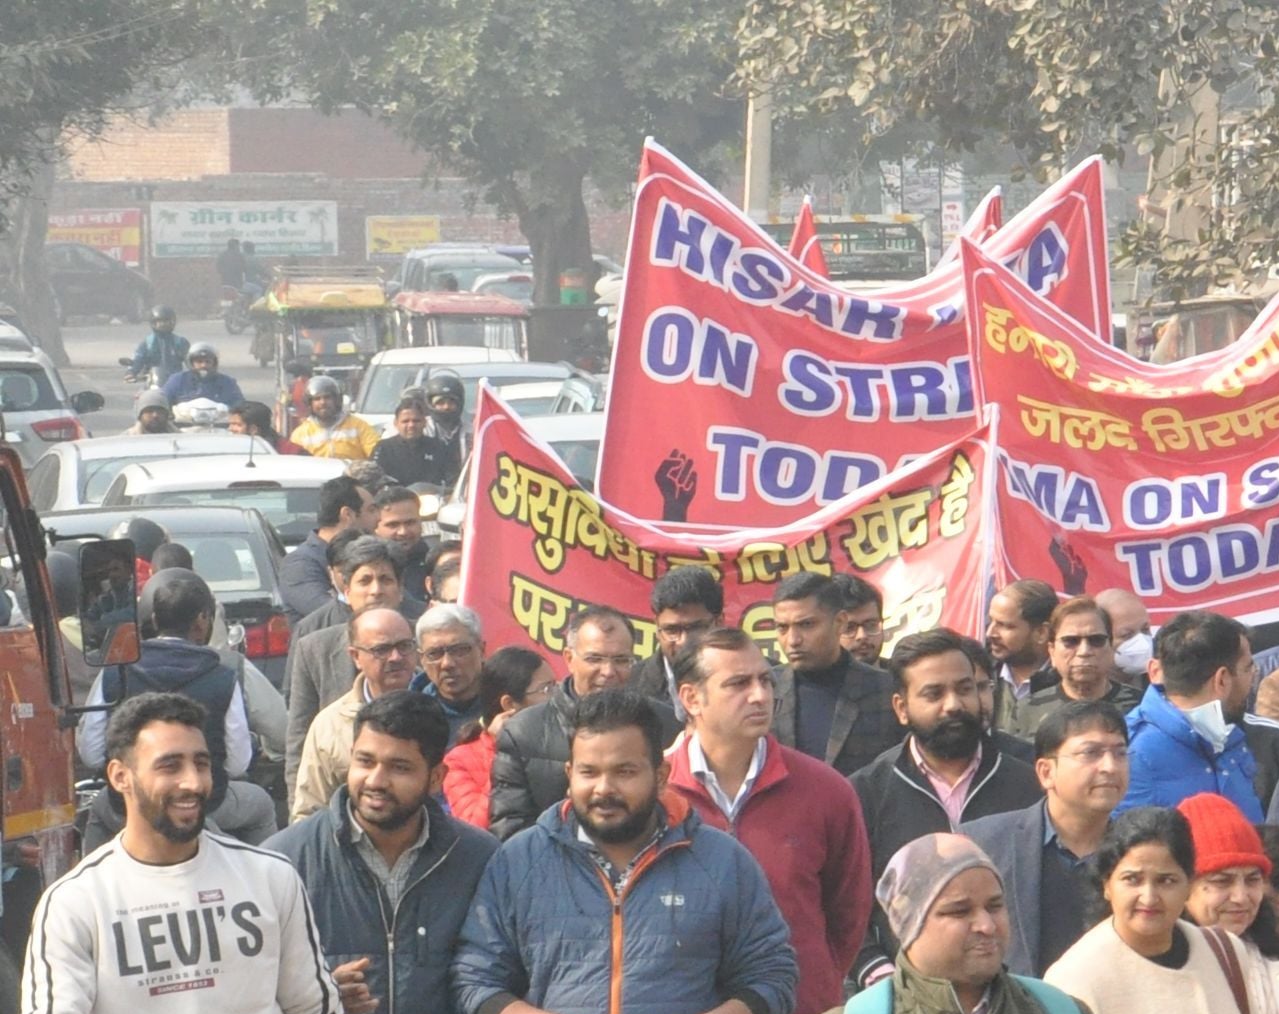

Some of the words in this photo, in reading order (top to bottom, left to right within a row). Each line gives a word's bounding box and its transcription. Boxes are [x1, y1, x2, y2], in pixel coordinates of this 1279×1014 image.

[655, 202, 902, 341] HISAR
[646, 311, 755, 393] ON
[784, 353, 974, 419] STRI
[939, 449, 976, 539] है
[1128, 477, 1222, 528] ON
[112, 900, 264, 977] LEVI'S
